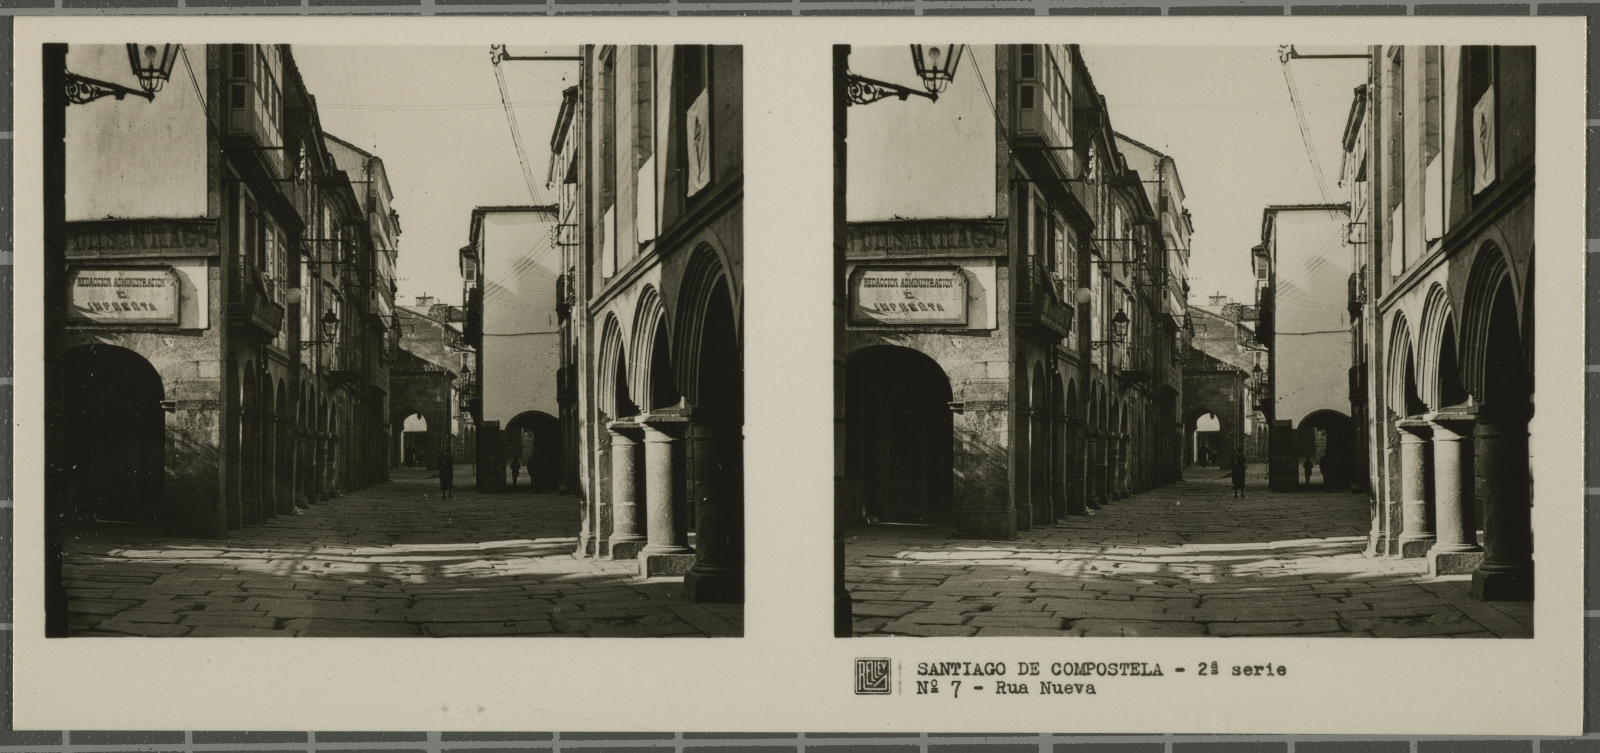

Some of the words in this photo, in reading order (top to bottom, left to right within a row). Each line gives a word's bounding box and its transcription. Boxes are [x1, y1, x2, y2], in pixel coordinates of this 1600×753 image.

[917, 662, 1006, 676] SANTIAGO
[1018, 662, 1040, 676] DE
[1051, 662, 1164, 677] COMPOSTELA
[1198, 660, 1219, 676] 2ª
[1232, 662, 1287, 676] serie
[916, 679, 939, 695] Nº
[951, 680, 962, 698] 7
[996, 681, 1029, 695] Rua
[1040, 681, 1097, 695] Nueva
